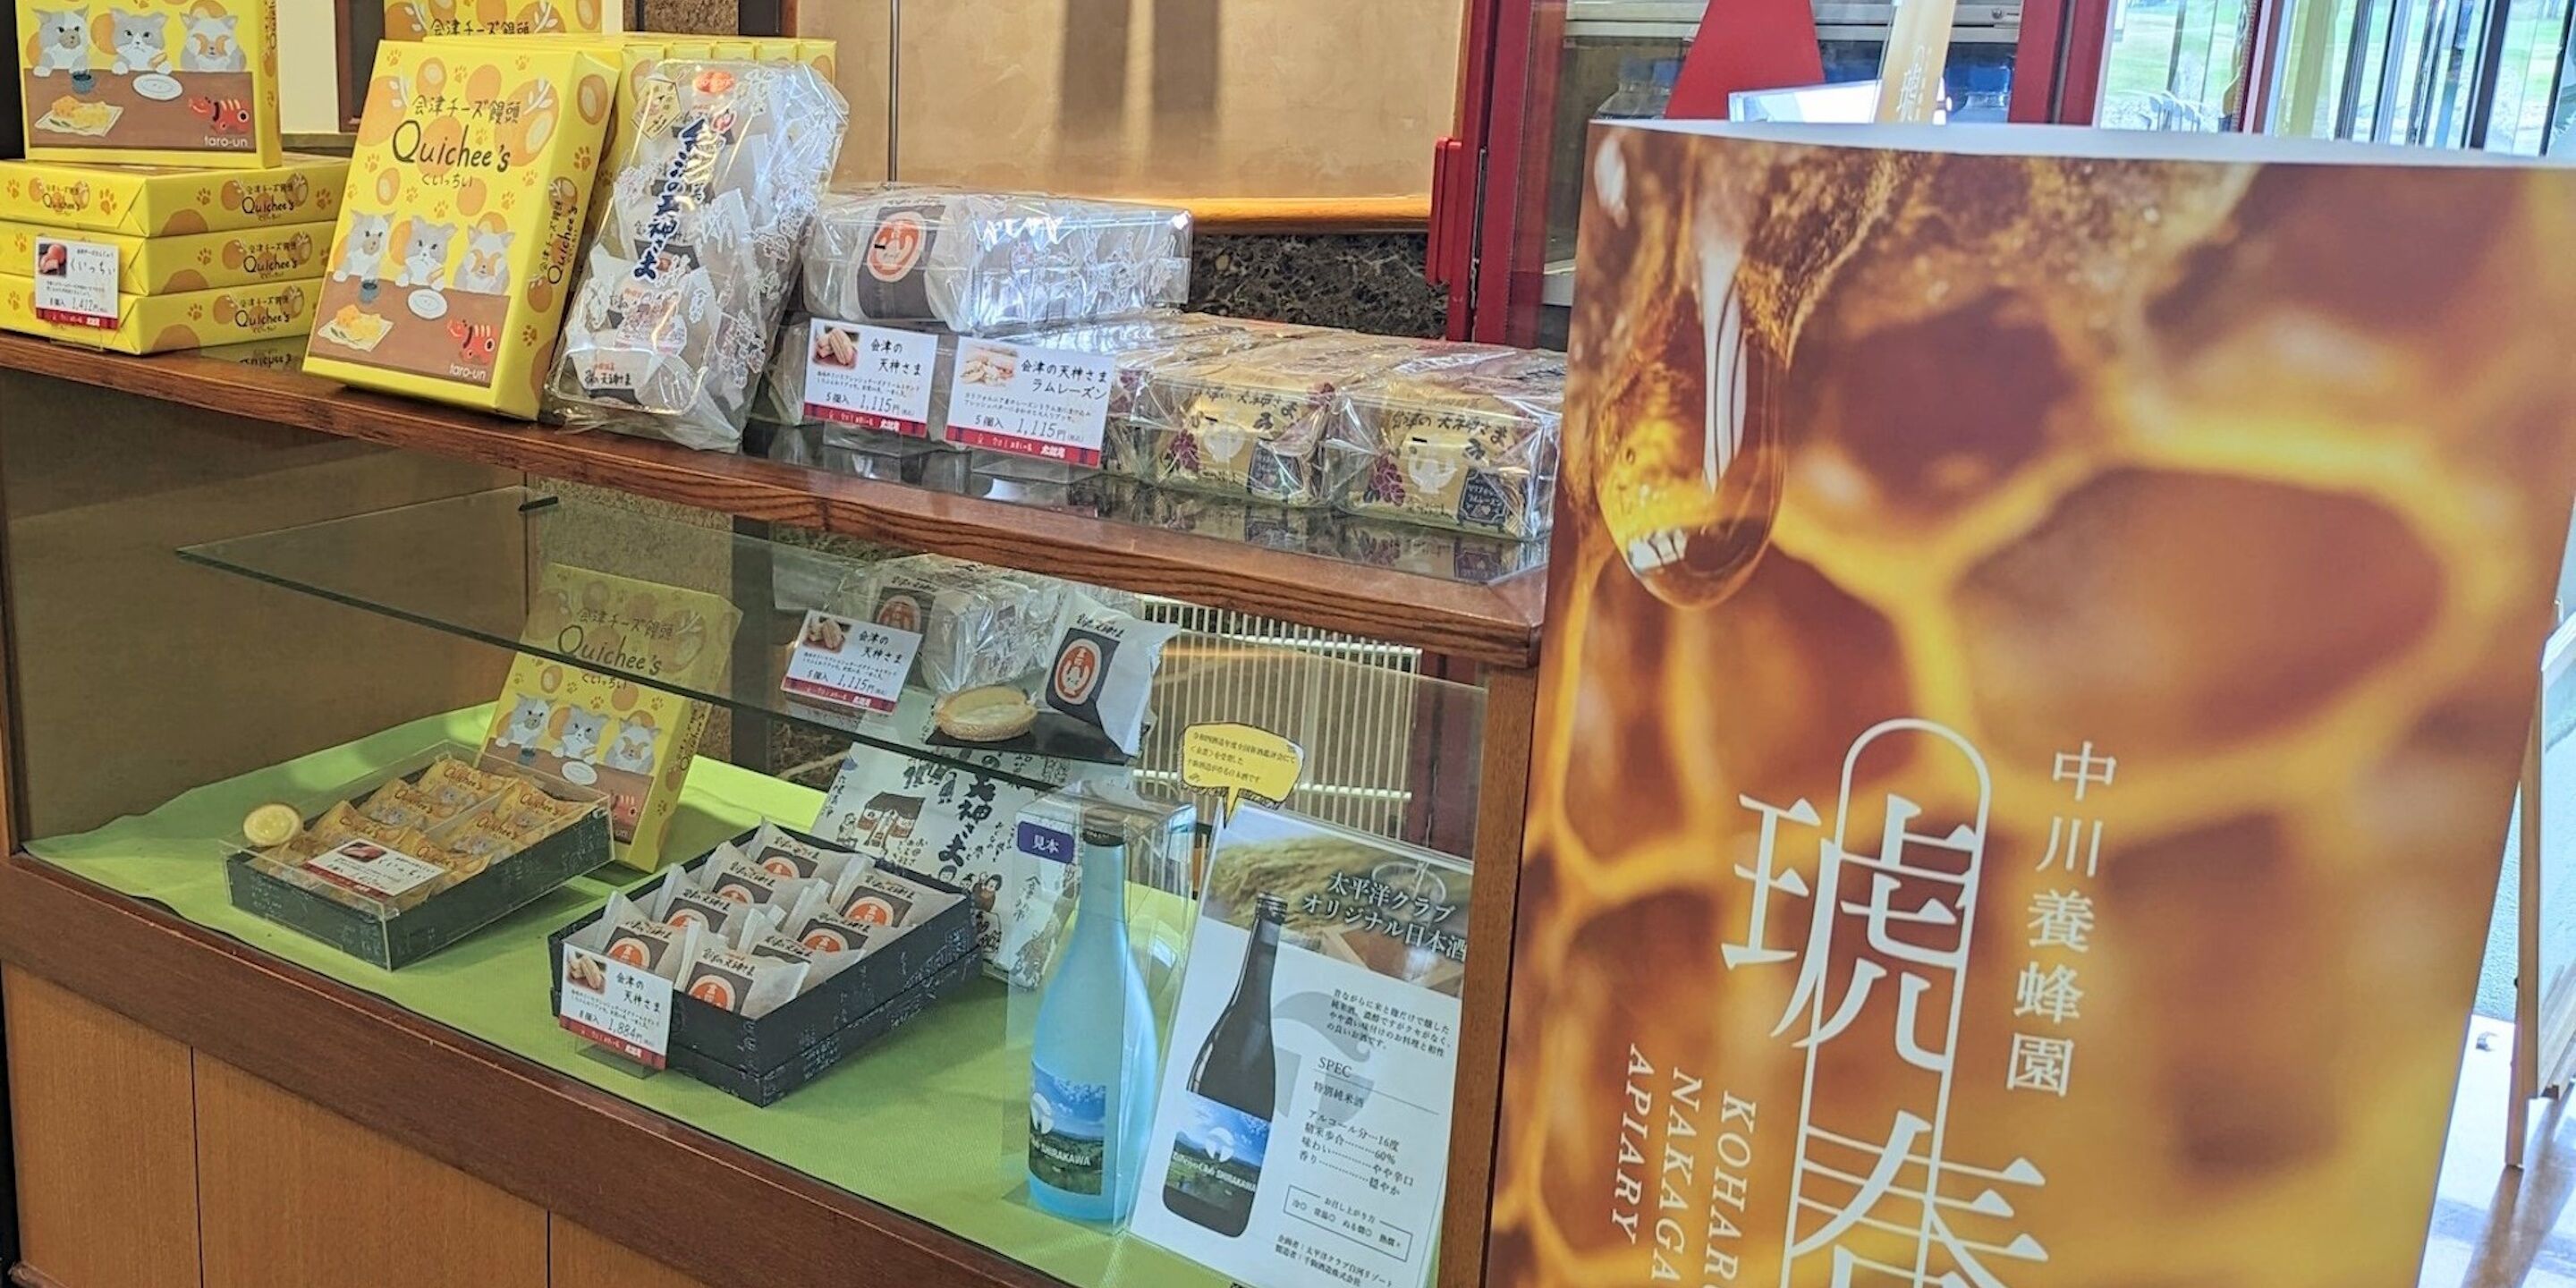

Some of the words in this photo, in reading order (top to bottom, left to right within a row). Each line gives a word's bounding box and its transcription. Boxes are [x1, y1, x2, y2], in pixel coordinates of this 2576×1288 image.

[412, 95, 521, 124] 会津チーズ饅頭
[204, 135, 249, 148] taro-un
[392, 119, 511, 173] Quichee's
[242, 194, 294, 214] Quichee's
[547, 204, 578, 284] Quichee's
[242, 252, 298, 273] Quichee's
[234, 307, 291, 327] Quichee's
[870, 338, 903, 354] 会津の
[449, 364, 487, 381] taro-un
[877, 359, 922, 377] 天神さま
[1021, 360, 1108, 384] 会津の天神さま
[1032, 378, 1107, 401] ラムレーズン
[859, 394, 900, 417] 1,115円
[1015, 418, 1066, 443] 1,115円
[558, 624, 663, 675] Quichee's
[859, 631, 889, 645] 会津の
[861, 647, 905, 665] 天神さま
[836, 674, 875, 694] 1,115円
[1031, 834, 1060, 854] 見本
[1328, 870, 1456, 924] 太平洋クラブ
[1302, 894, 1468, 962] オリジナル日本酒
[2004, 740, 2117, 1097] 中川養蜂園
[616, 971, 645, 990] 会津の
[624, 990, 661, 1014] 天神さま
[1326, 1022, 1386, 1050] の良いお酒です。
[1318, 1056, 1352, 1078] SPEC
[1313, 1080, 1365, 1108] 特別純米酒
[1304, 1122, 1344, 1146] 精米歩合
[1611, 1043, 1655, 1245] APIARY
[1041, 1142, 1091, 1166] SHIRAKAWA
[1301, 1136, 1329, 1154] 味わい
[1372, 1163, 1415, 1188] やや辛口
[1299, 1149, 1318, 1165] 香り
[1368, 1176, 1402, 1197] 穏やか
[1650, 1066, 1702, 1282] NAKAGA
[1703, 1090, 1757, 1288] KOHAR
